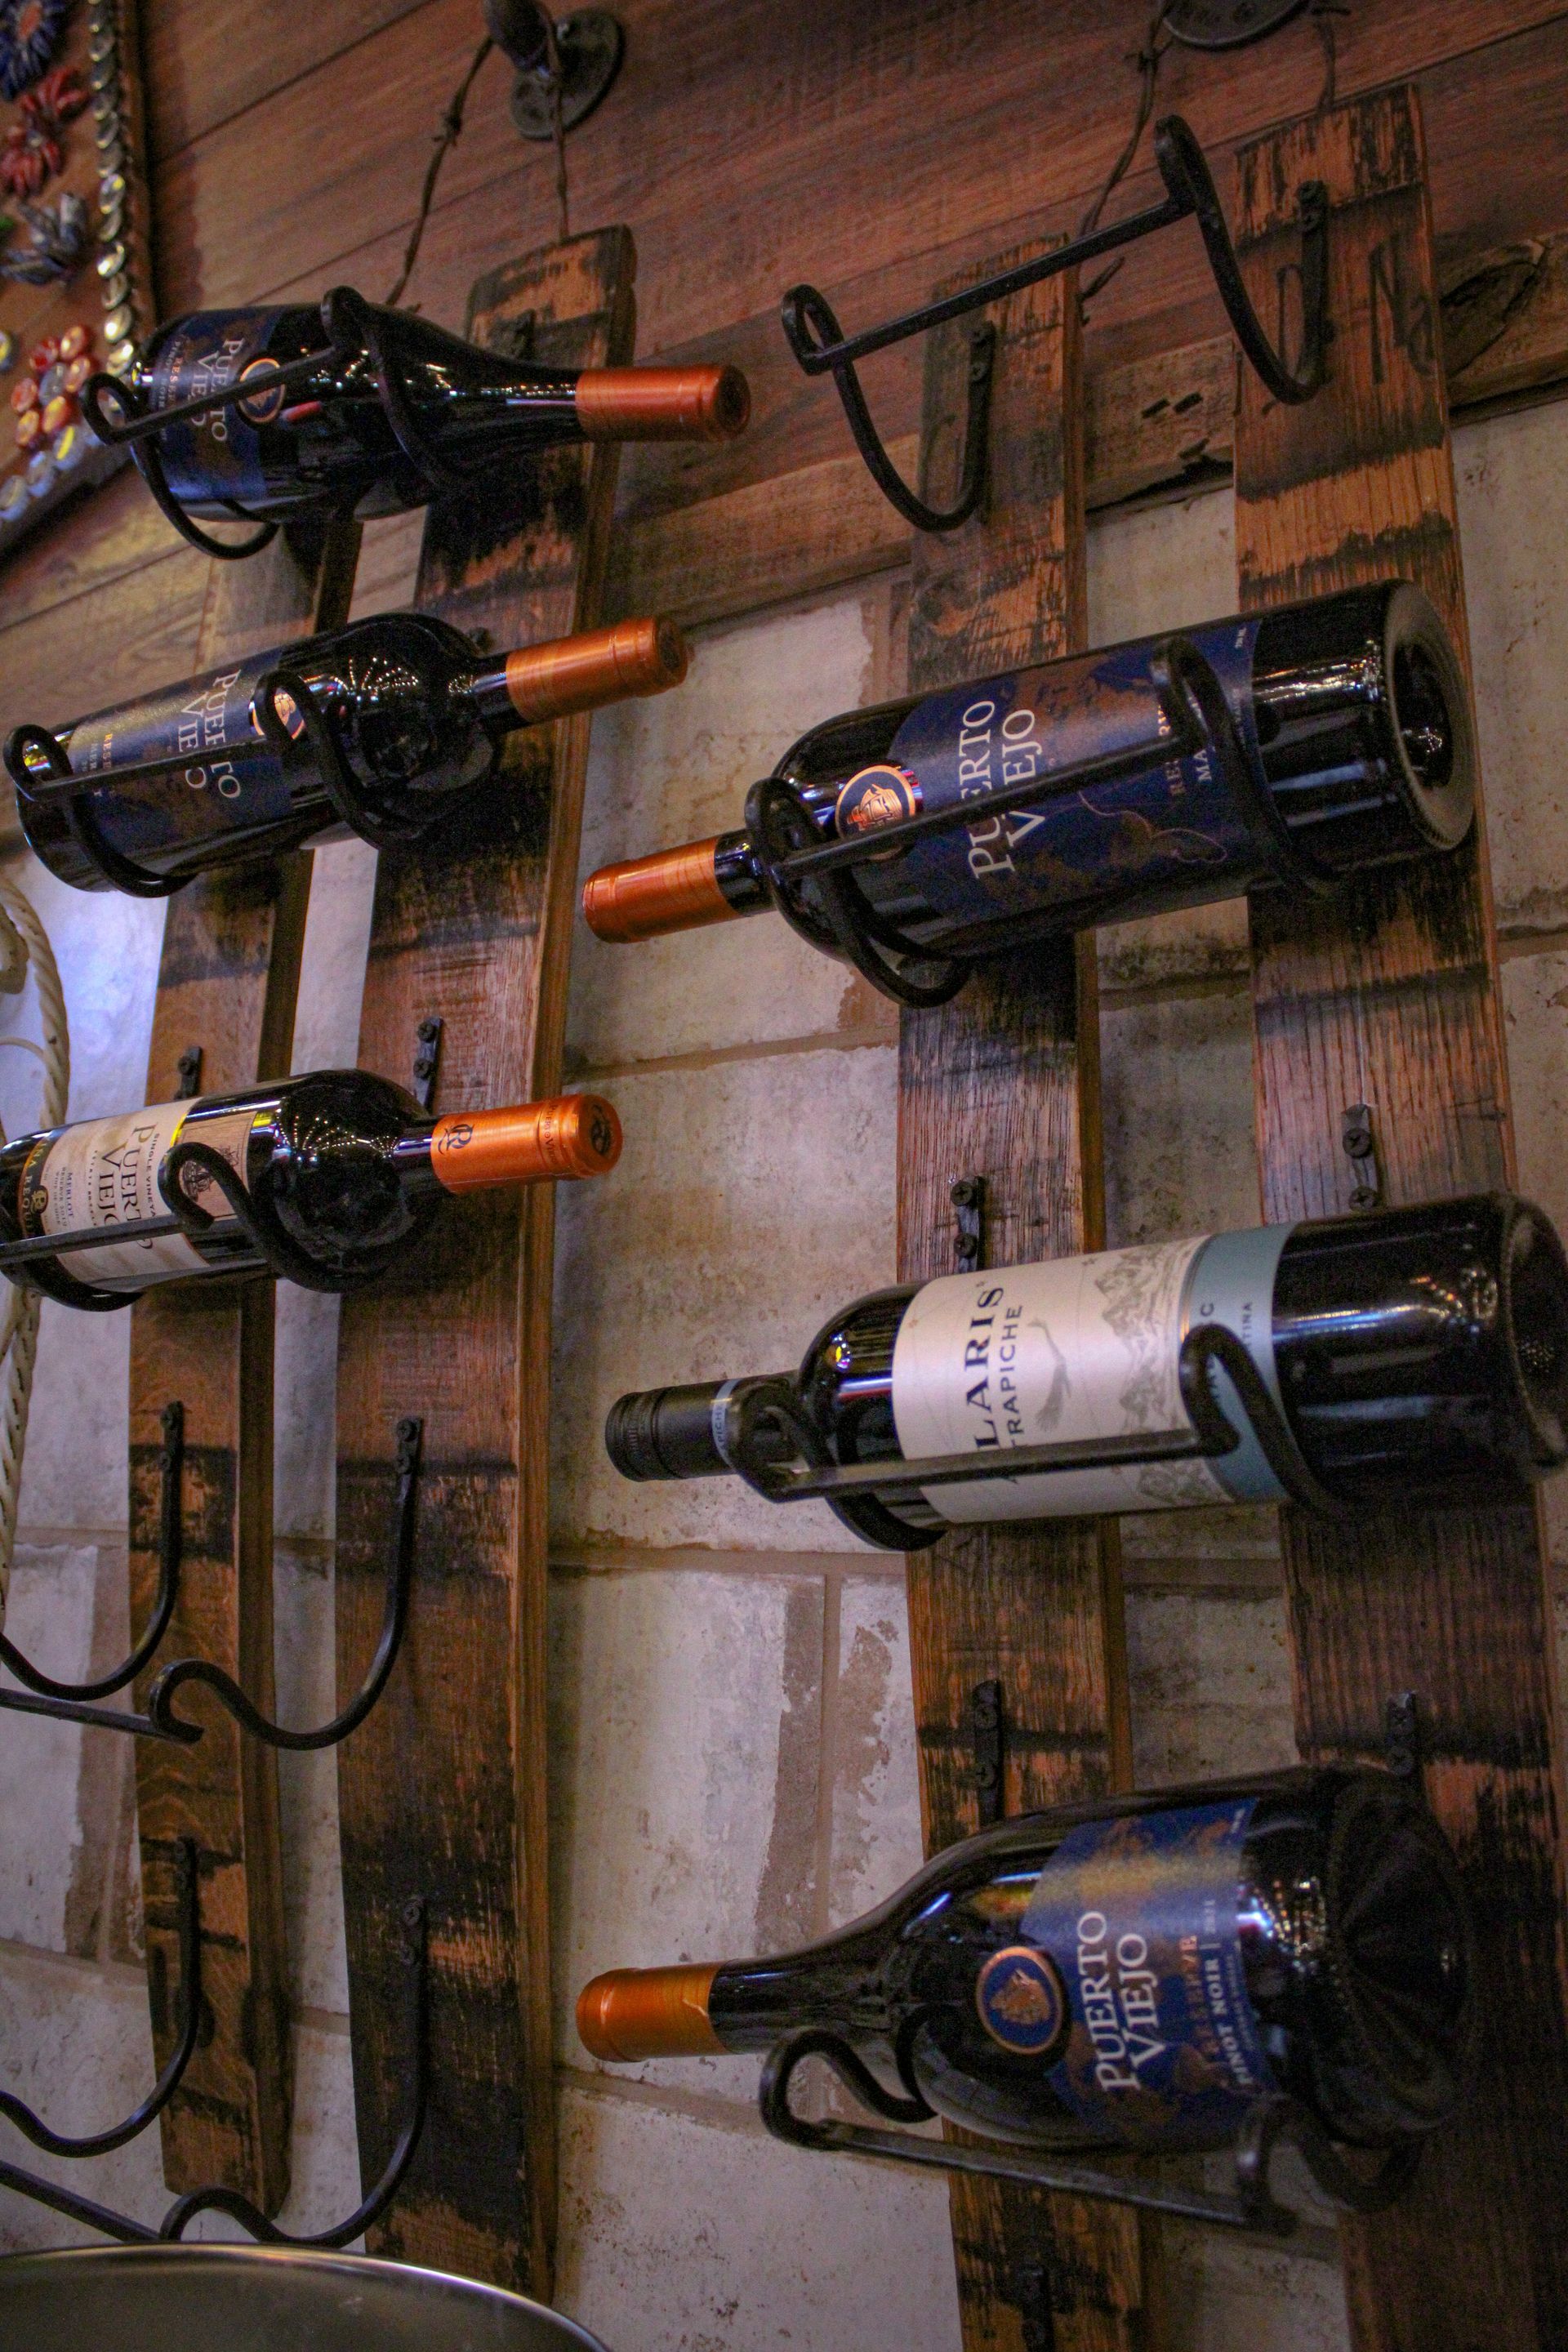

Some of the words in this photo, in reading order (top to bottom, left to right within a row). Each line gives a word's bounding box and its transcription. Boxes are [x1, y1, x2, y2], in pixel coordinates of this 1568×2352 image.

[209, 337, 245, 442] PUETO
[1001, 709, 1046, 848] VEJO
[65, 1171, 74, 1218] MERLOT
[145, 1133, 161, 1173] SINGLE
[1076, 1910, 1142, 2092] PUERTO
[1116, 1932, 1166, 2069] VIEJO
[1204, 1958, 1227, 2016] NOIR
[1216, 2023, 1253, 2086] PINOT
